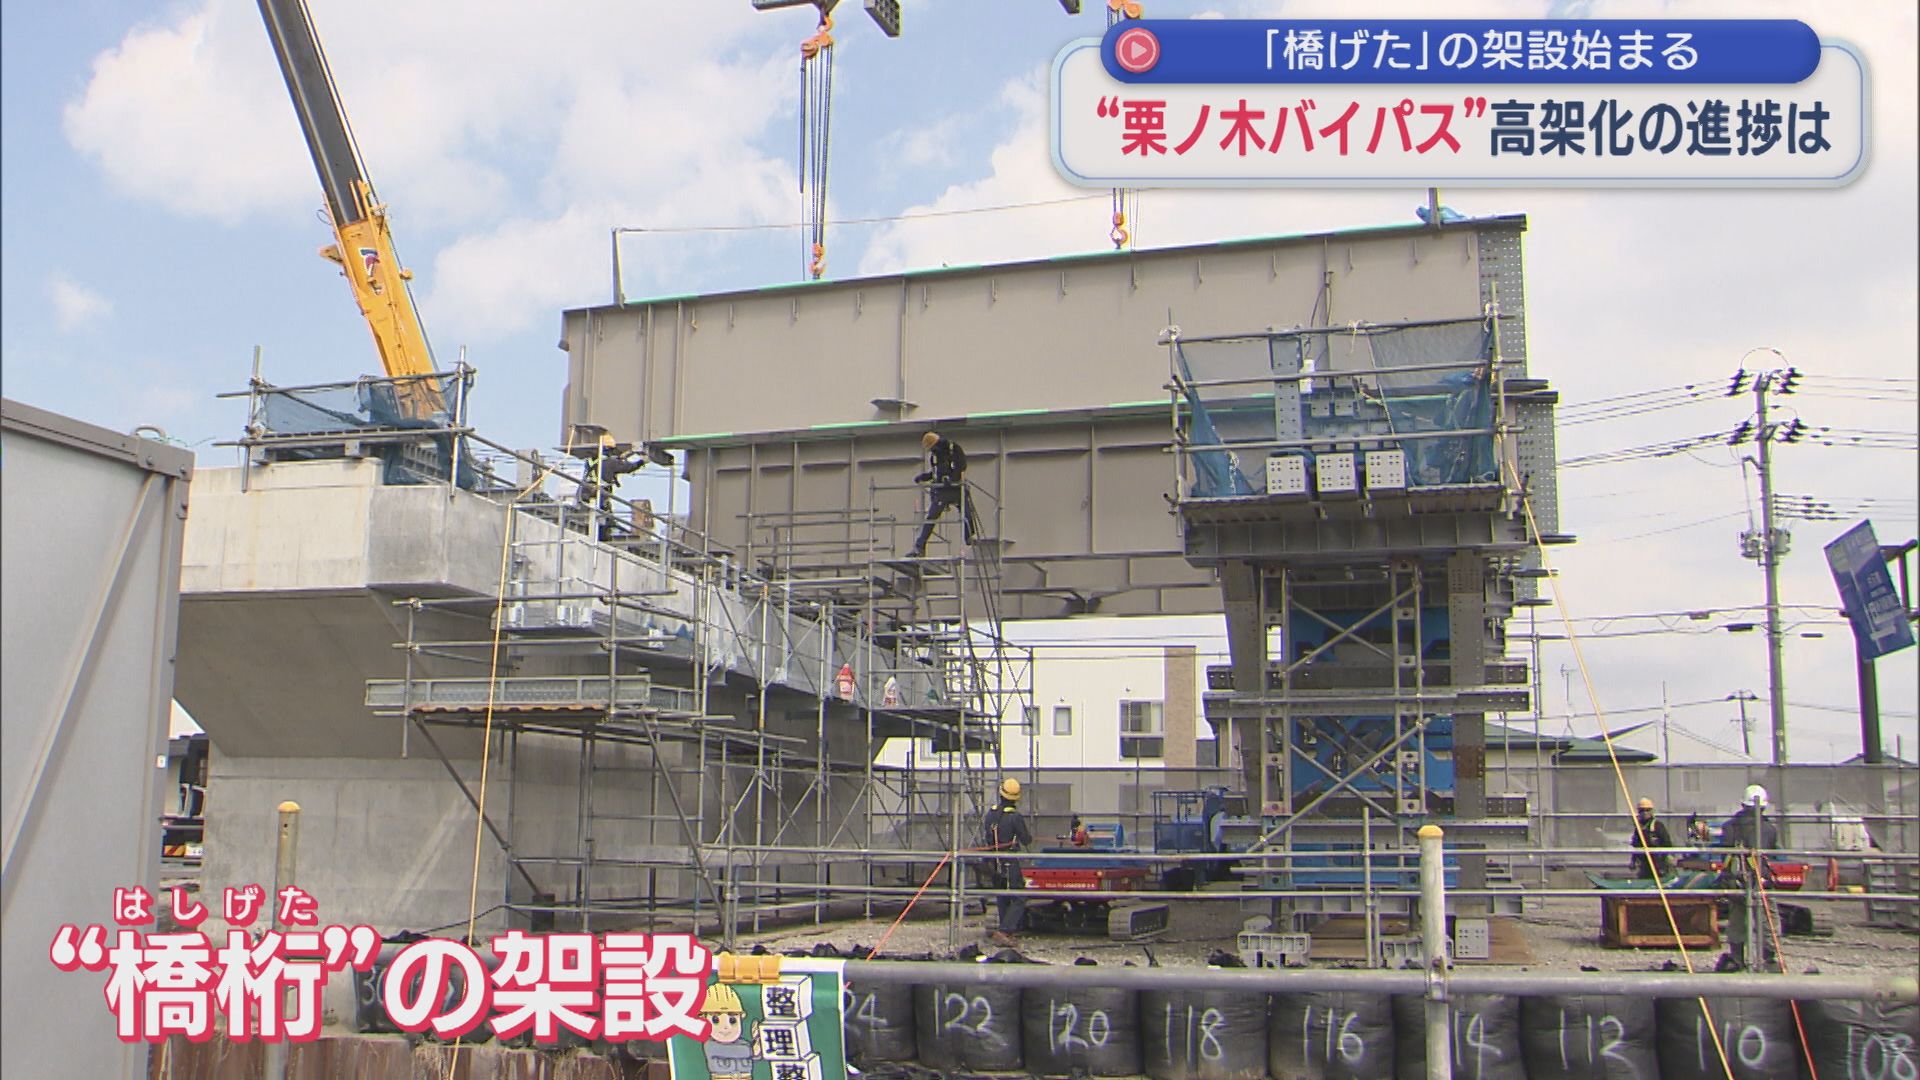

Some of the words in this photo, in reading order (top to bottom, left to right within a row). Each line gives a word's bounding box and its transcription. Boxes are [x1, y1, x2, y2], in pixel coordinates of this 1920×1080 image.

[934, 988, 1008, 1046] 122
[1050, 999, 1110, 1055] 120
[1166, 1002, 1226, 1066] 118
[1303, 1004, 1364, 1067] 116
[1559, 1008, 1634, 1076] 112
[1697, 1014, 1766, 1072] 110
[1847, 1025, 1917, 1080] 108
